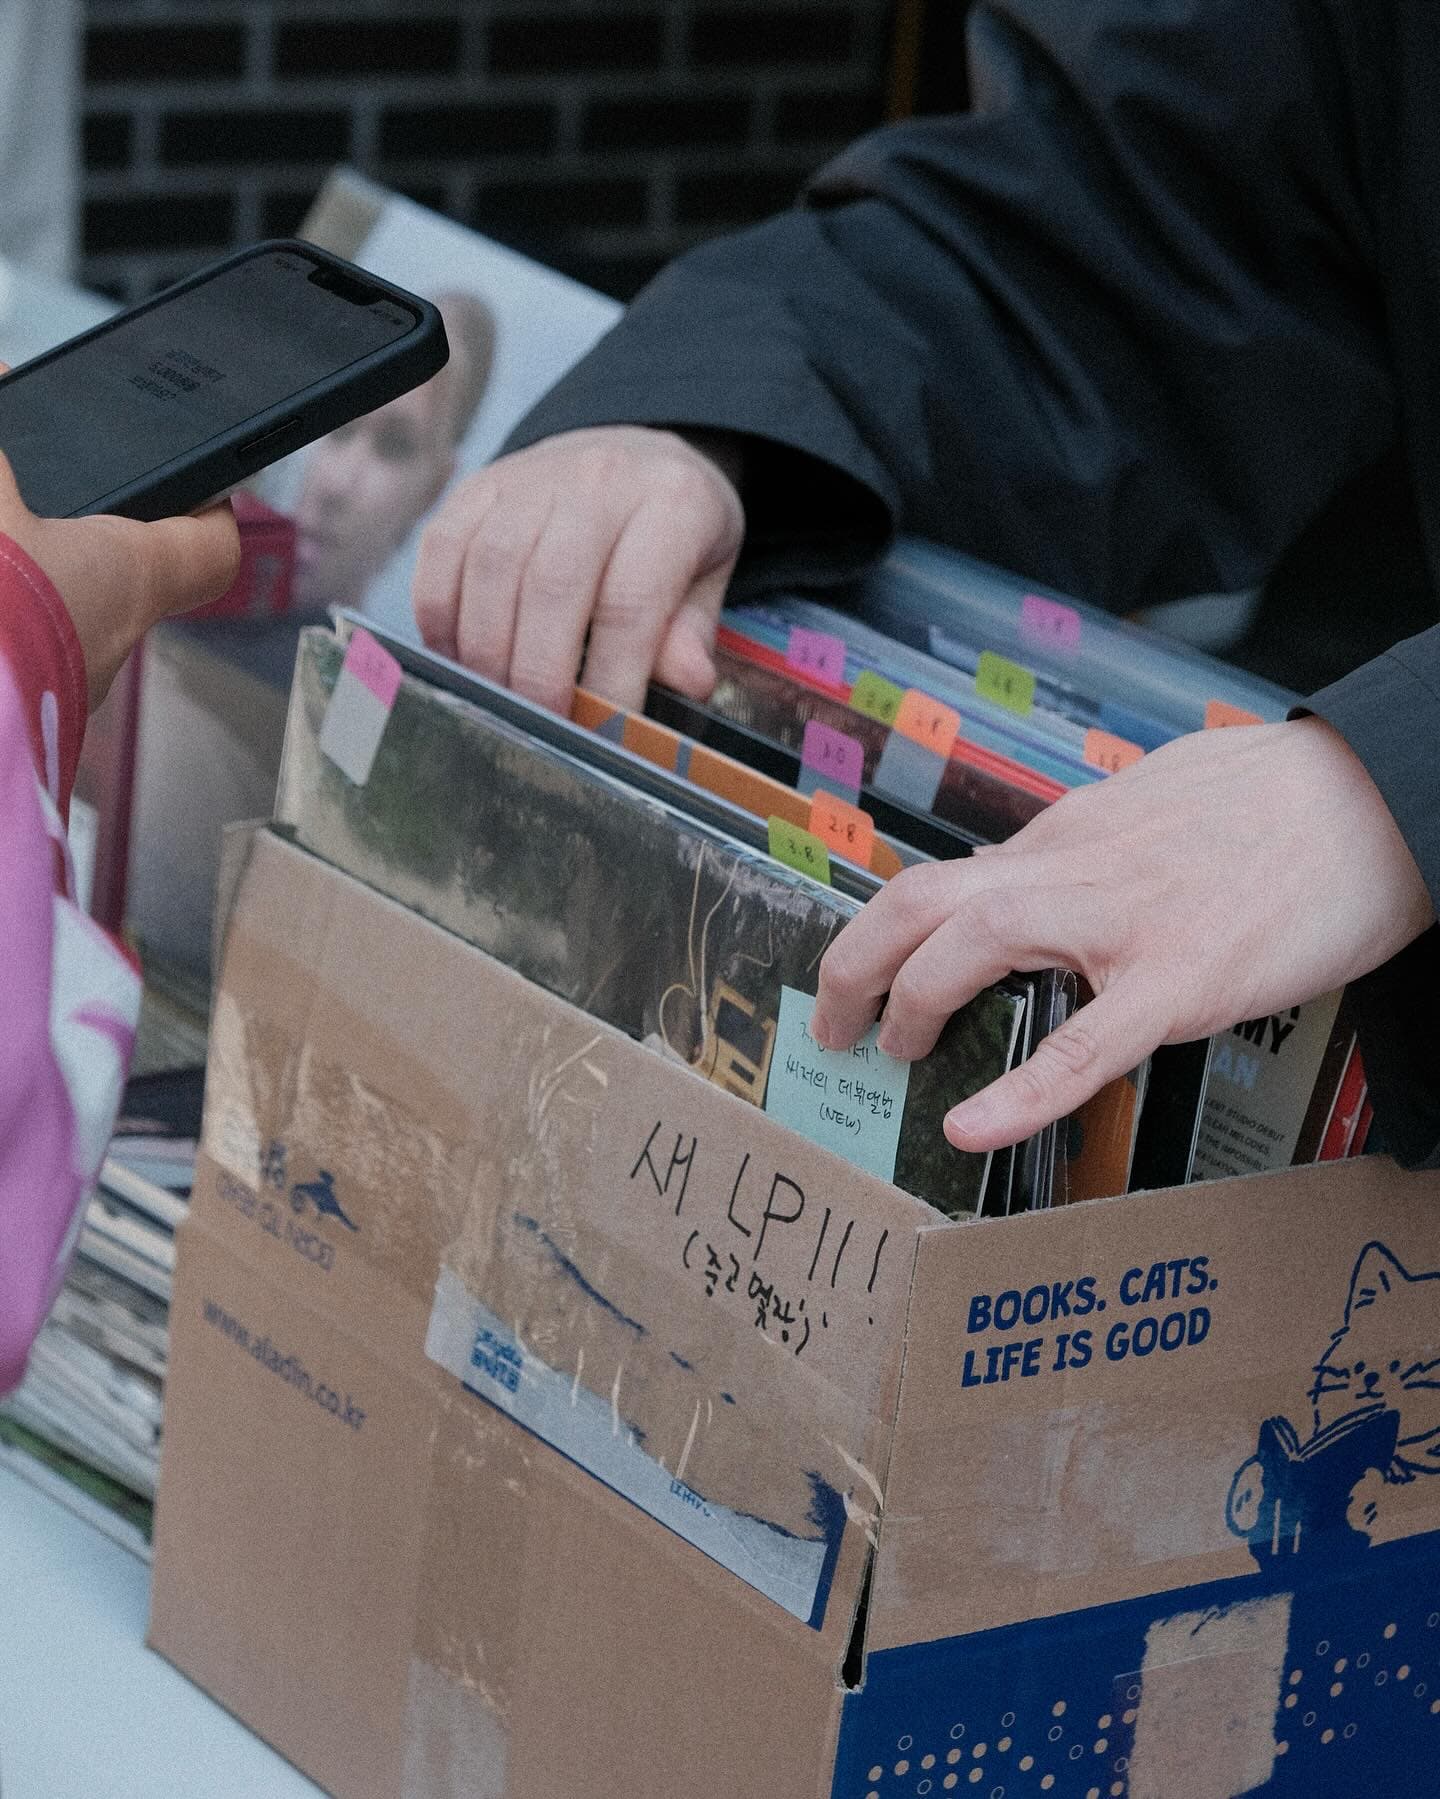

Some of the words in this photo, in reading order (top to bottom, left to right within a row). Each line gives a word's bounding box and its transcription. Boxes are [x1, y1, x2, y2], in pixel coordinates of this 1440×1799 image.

[819, 1102, 861, 1136] (NEW)
[630, 1120, 698, 1217] 새
[966, 1276, 1107, 1335] BOOKS.
[1119, 1255, 1219, 1306] CATS.
[960, 1338, 1044, 1388] LIFE
[1052, 1329, 1093, 1371] IS
[1105, 1306, 1212, 1361] GOOD
